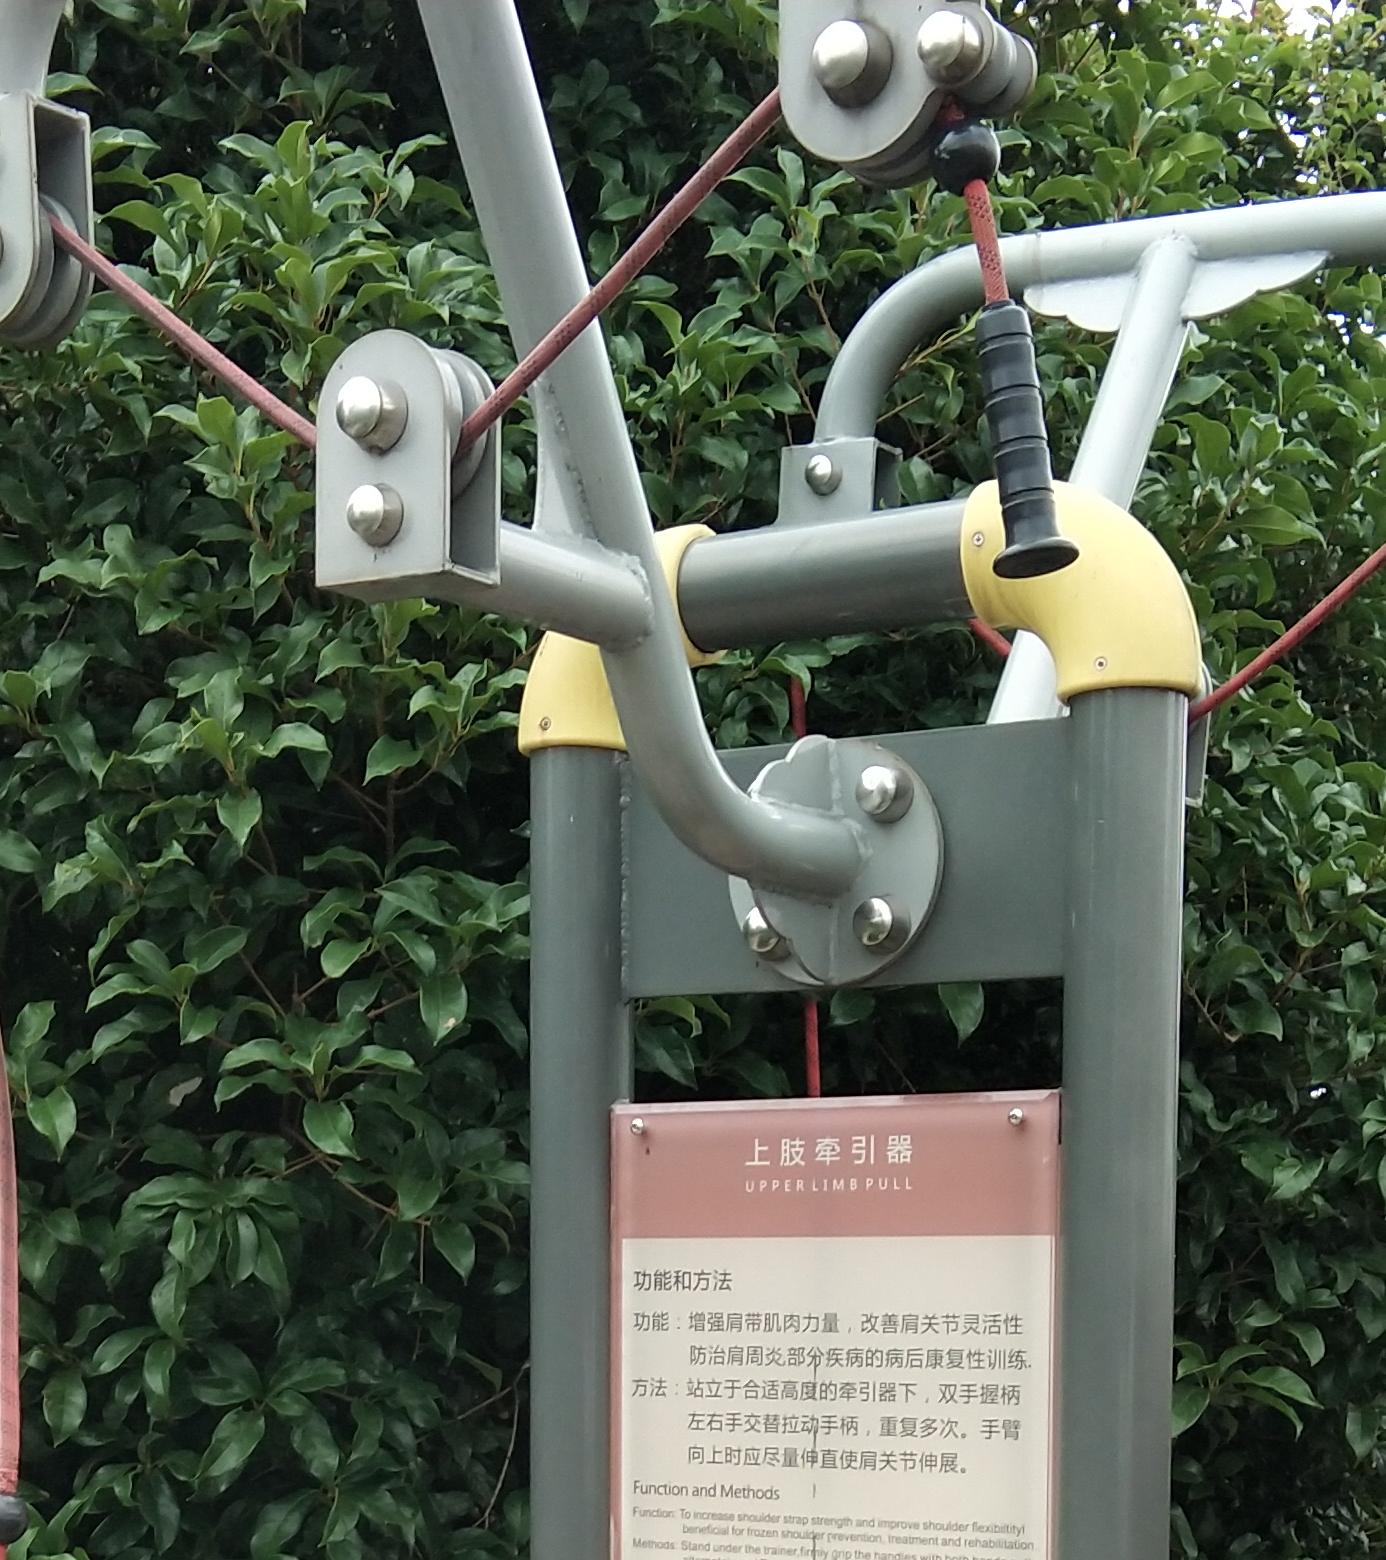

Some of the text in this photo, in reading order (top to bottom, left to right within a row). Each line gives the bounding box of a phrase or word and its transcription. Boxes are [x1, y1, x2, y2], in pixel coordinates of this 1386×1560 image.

[745, 1135, 912, 1166] 上肢牵引器
[746, 1177, 912, 1192] UPPER LIMB PULL
[634, 1269, 732, 1291] 功能和方法
[634, 1480, 780, 1500] Function and Methods
[680, 1509, 691, 1519] To
[694, 1510, 735, 1521] increase
[738, 1511, 780, 1523] shoulder
[783, 1515, 808, 1525] strap
[812, 1516, 853, 1528] strength
[856, 1519, 874, 1528] and
[878, 1520, 919, 1531] improve
[923, 1521, 969, 1532] shoulder
[683, 1524, 729, 1535] beneficial
[732, 1526, 744, 1536] for
[747, 1527, 779, 1537] frozen
[781, 1529, 824, 1540] shoulder
[888, 1535, 938, 1546] treatment
[942, 1537, 961, 1547] and
[681, 1540, 710, 1551] Stand
[713, 1542, 742, 1553] under
[745, 1544, 761, 1554] the
[832, 1550, 851, 1560] grip
[855, 1551, 870, 1560] the
